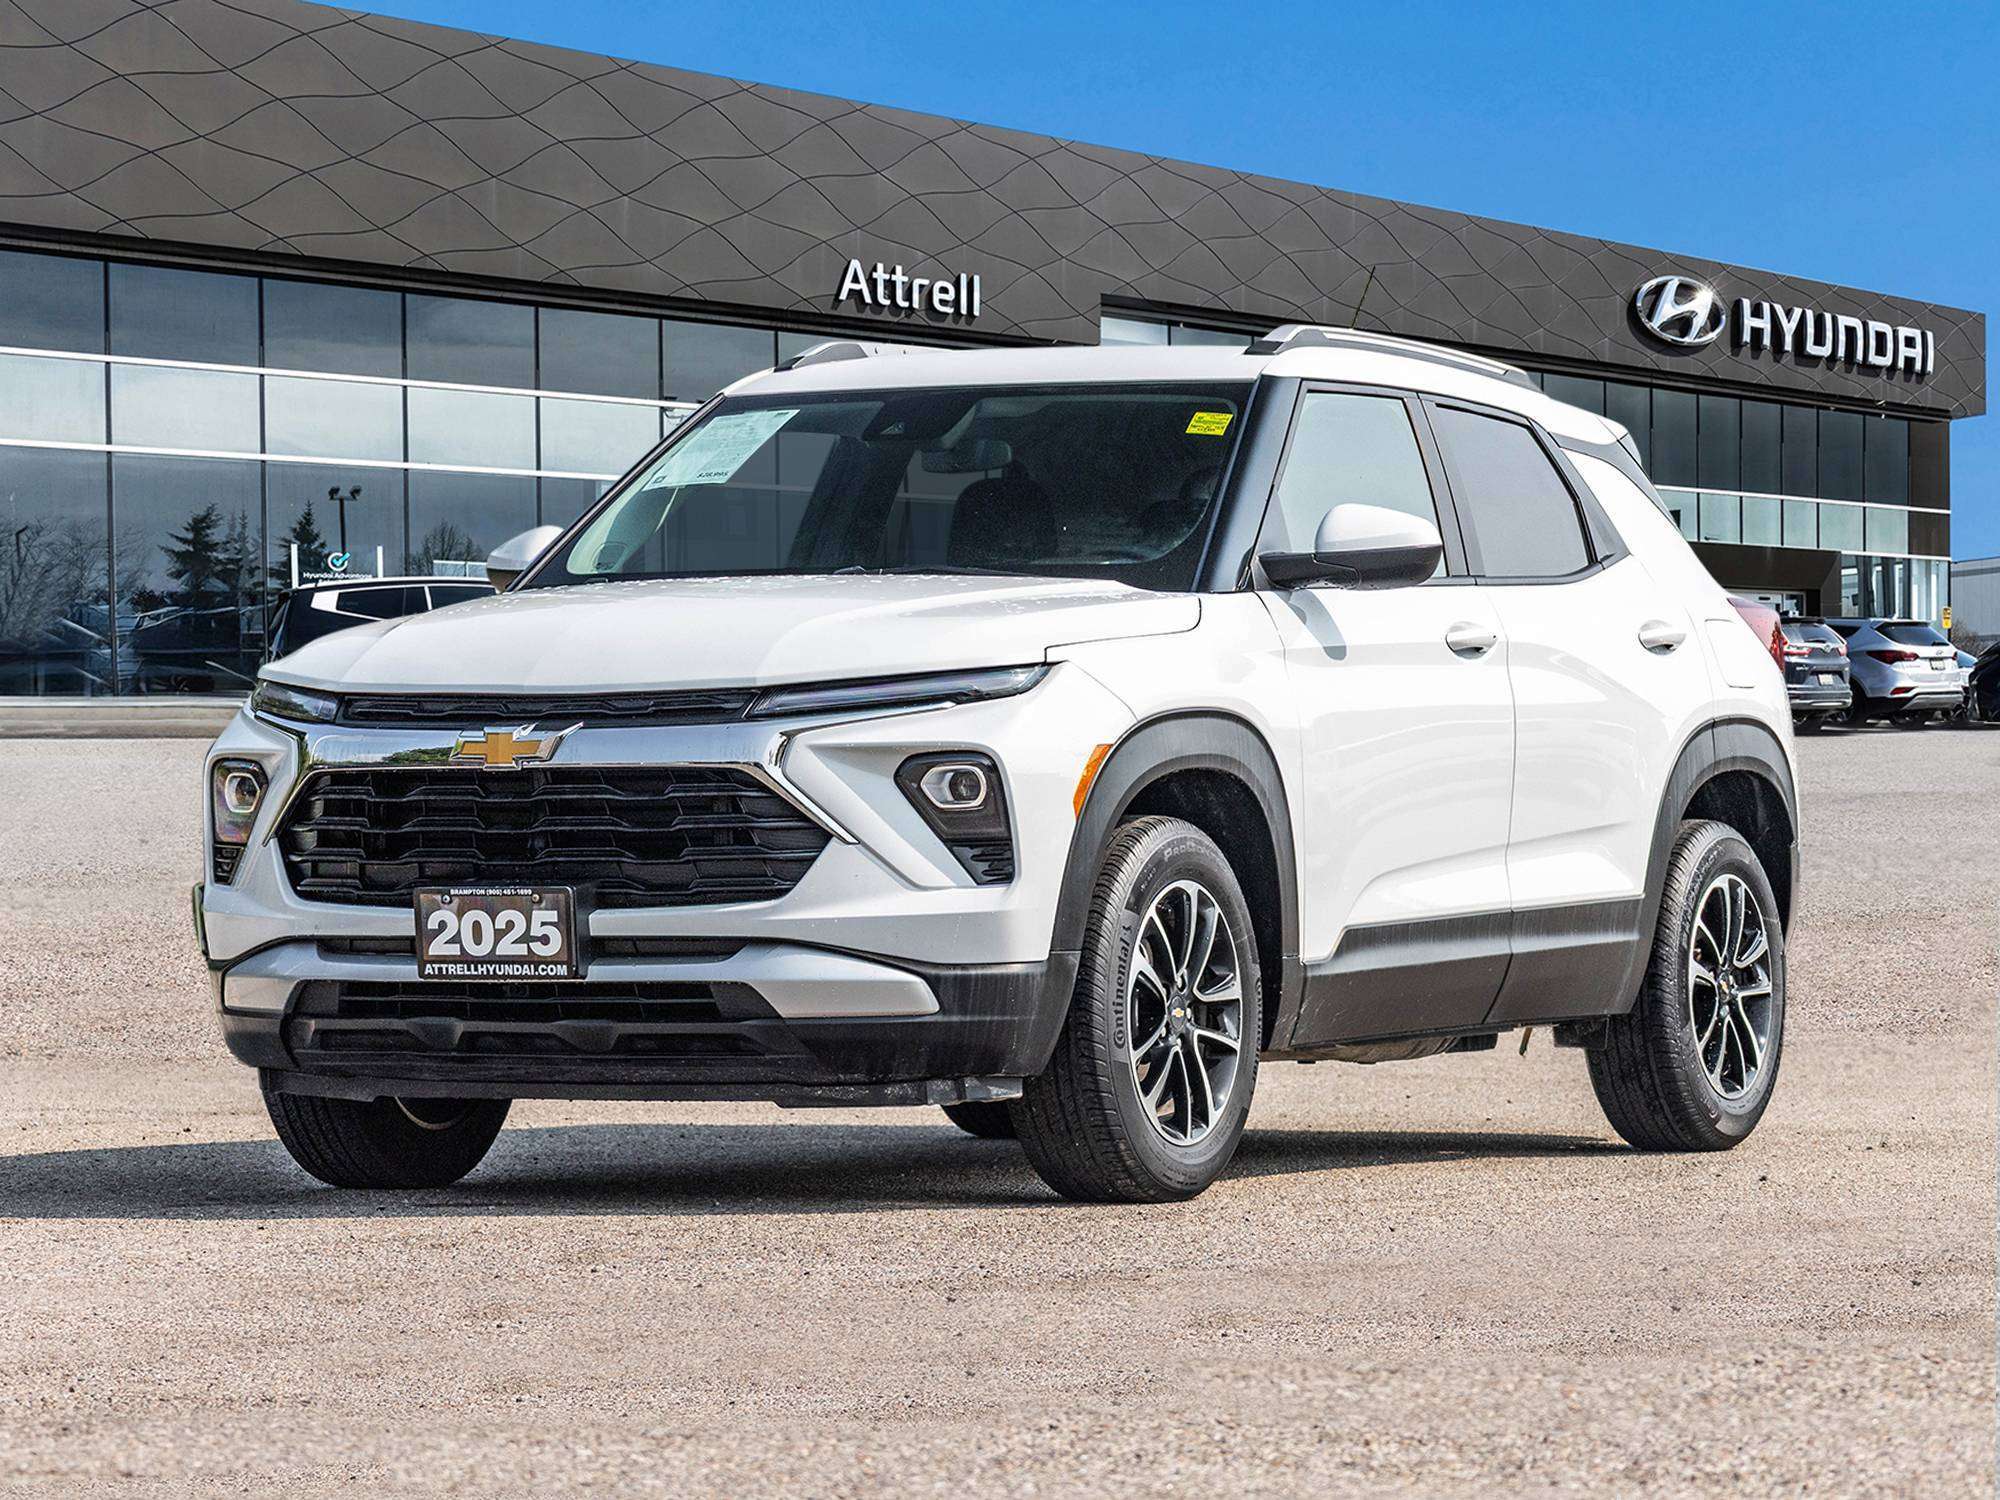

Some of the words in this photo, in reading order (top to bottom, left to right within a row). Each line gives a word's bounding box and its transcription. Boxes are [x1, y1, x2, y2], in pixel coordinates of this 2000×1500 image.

[838, 259, 981, 317] Attrell
[1738, 298, 1935, 376] HYUNDAI
[486, 888, 502, 896] (905)
[427, 909, 562, 957] 2025
[424, 964, 568, 976] ATTRELLHYUNDAI.COM
[1112, 936, 1130, 1049] Continental
